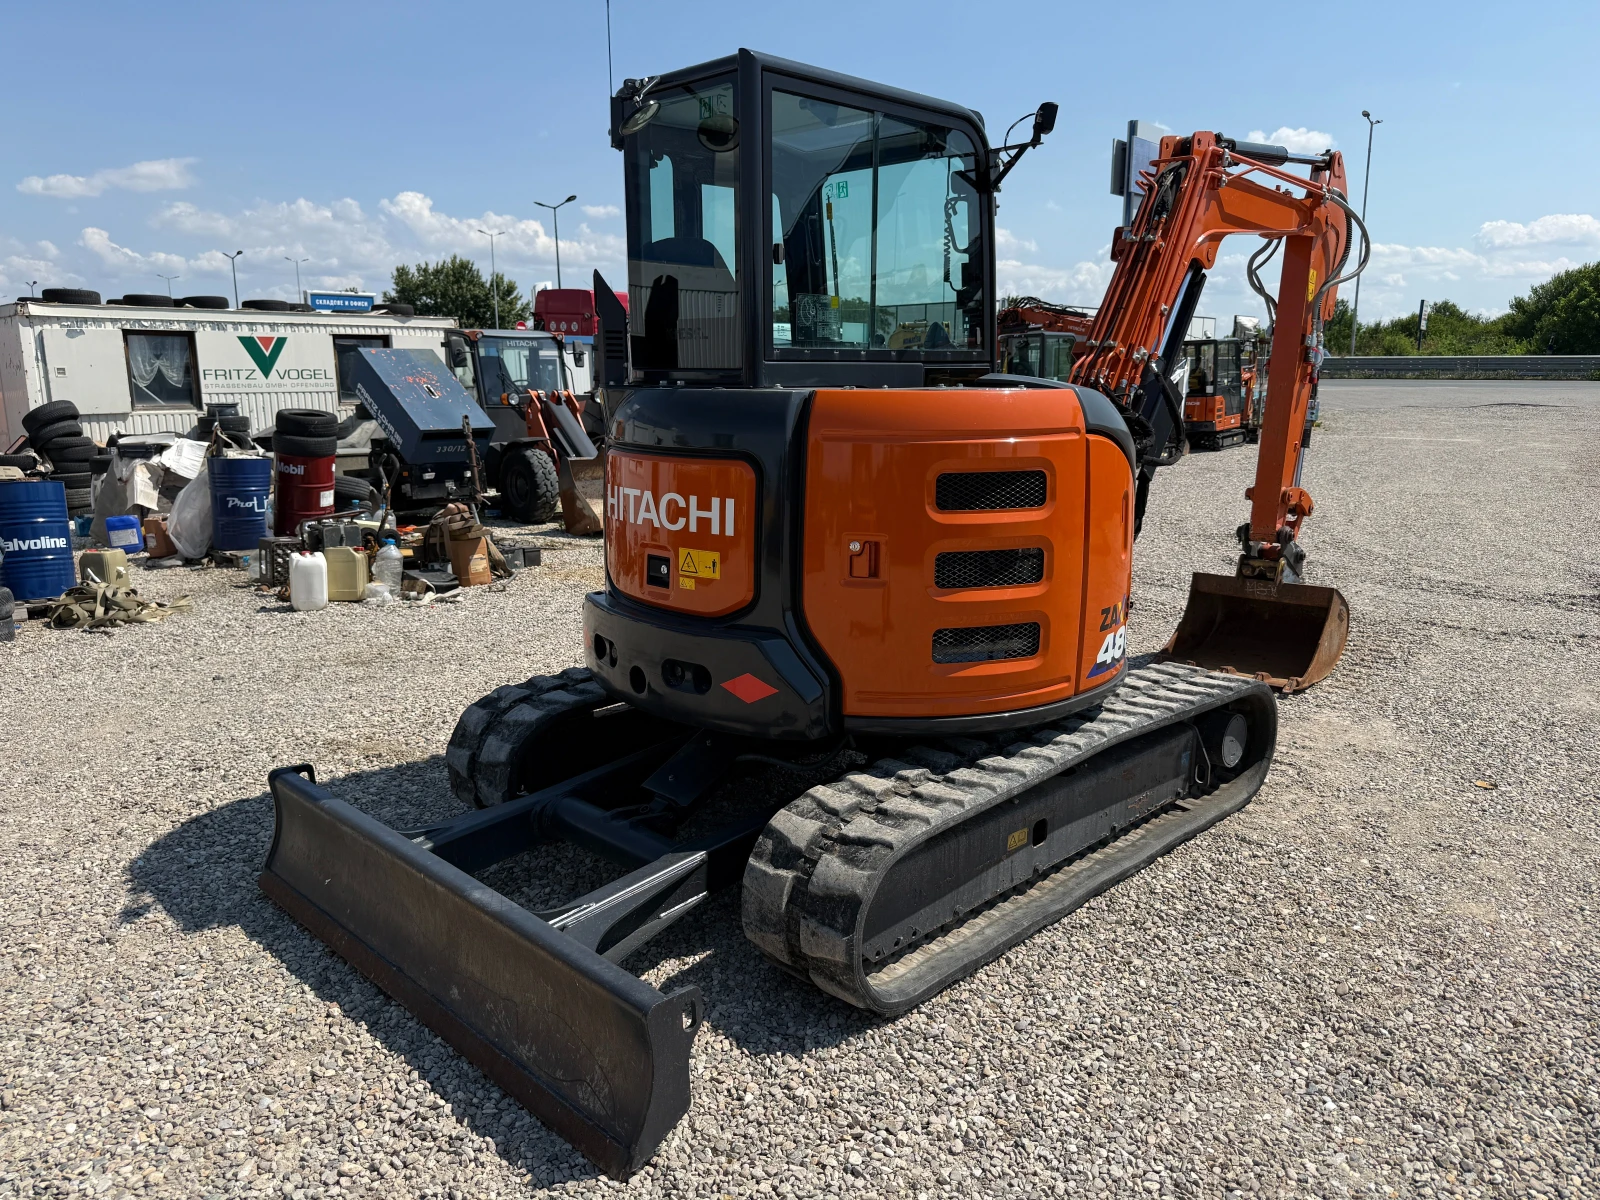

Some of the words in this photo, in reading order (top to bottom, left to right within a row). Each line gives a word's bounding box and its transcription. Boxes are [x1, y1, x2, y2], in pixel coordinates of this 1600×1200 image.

[203, 369, 257, 380] FRITZ
[275, 369, 333, 380] VOGEL
[436, 445, 466, 453] 330/12
[277, 461, 304, 475] Mobil
[607, 483, 735, 537] HITACHI
[4, 536, 66, 551] alvoline
[1096, 625, 1126, 665] 48
